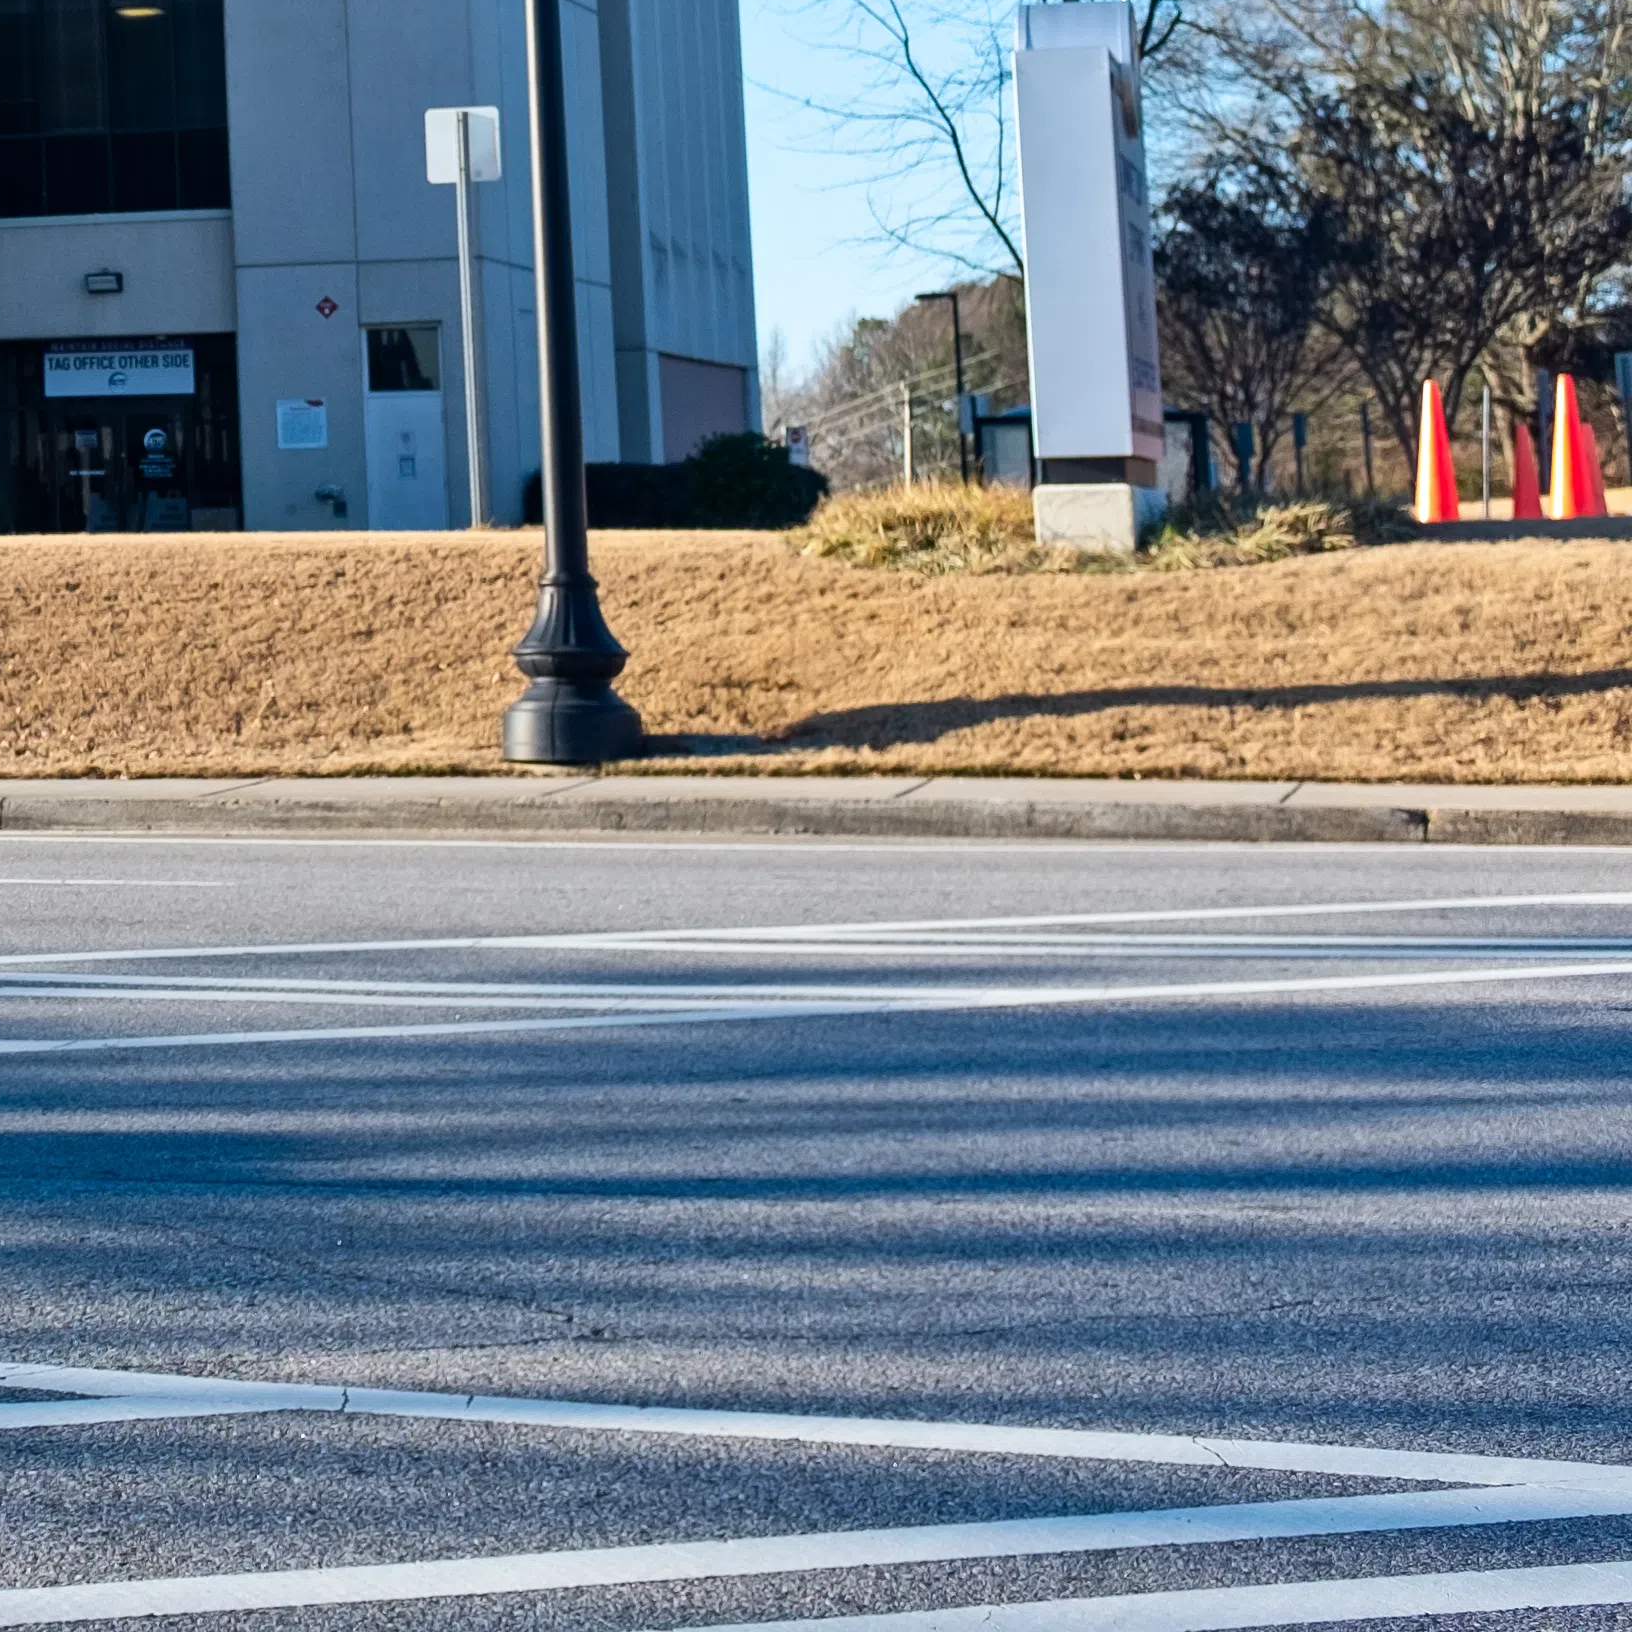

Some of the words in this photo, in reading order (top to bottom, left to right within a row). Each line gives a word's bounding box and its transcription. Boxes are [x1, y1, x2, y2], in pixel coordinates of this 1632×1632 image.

[47, 357, 70, 372] TAG
[73, 356, 116, 371] OFFICE
[118, 354, 159, 370] OTHER
[162, 353, 189, 369] SIDE
